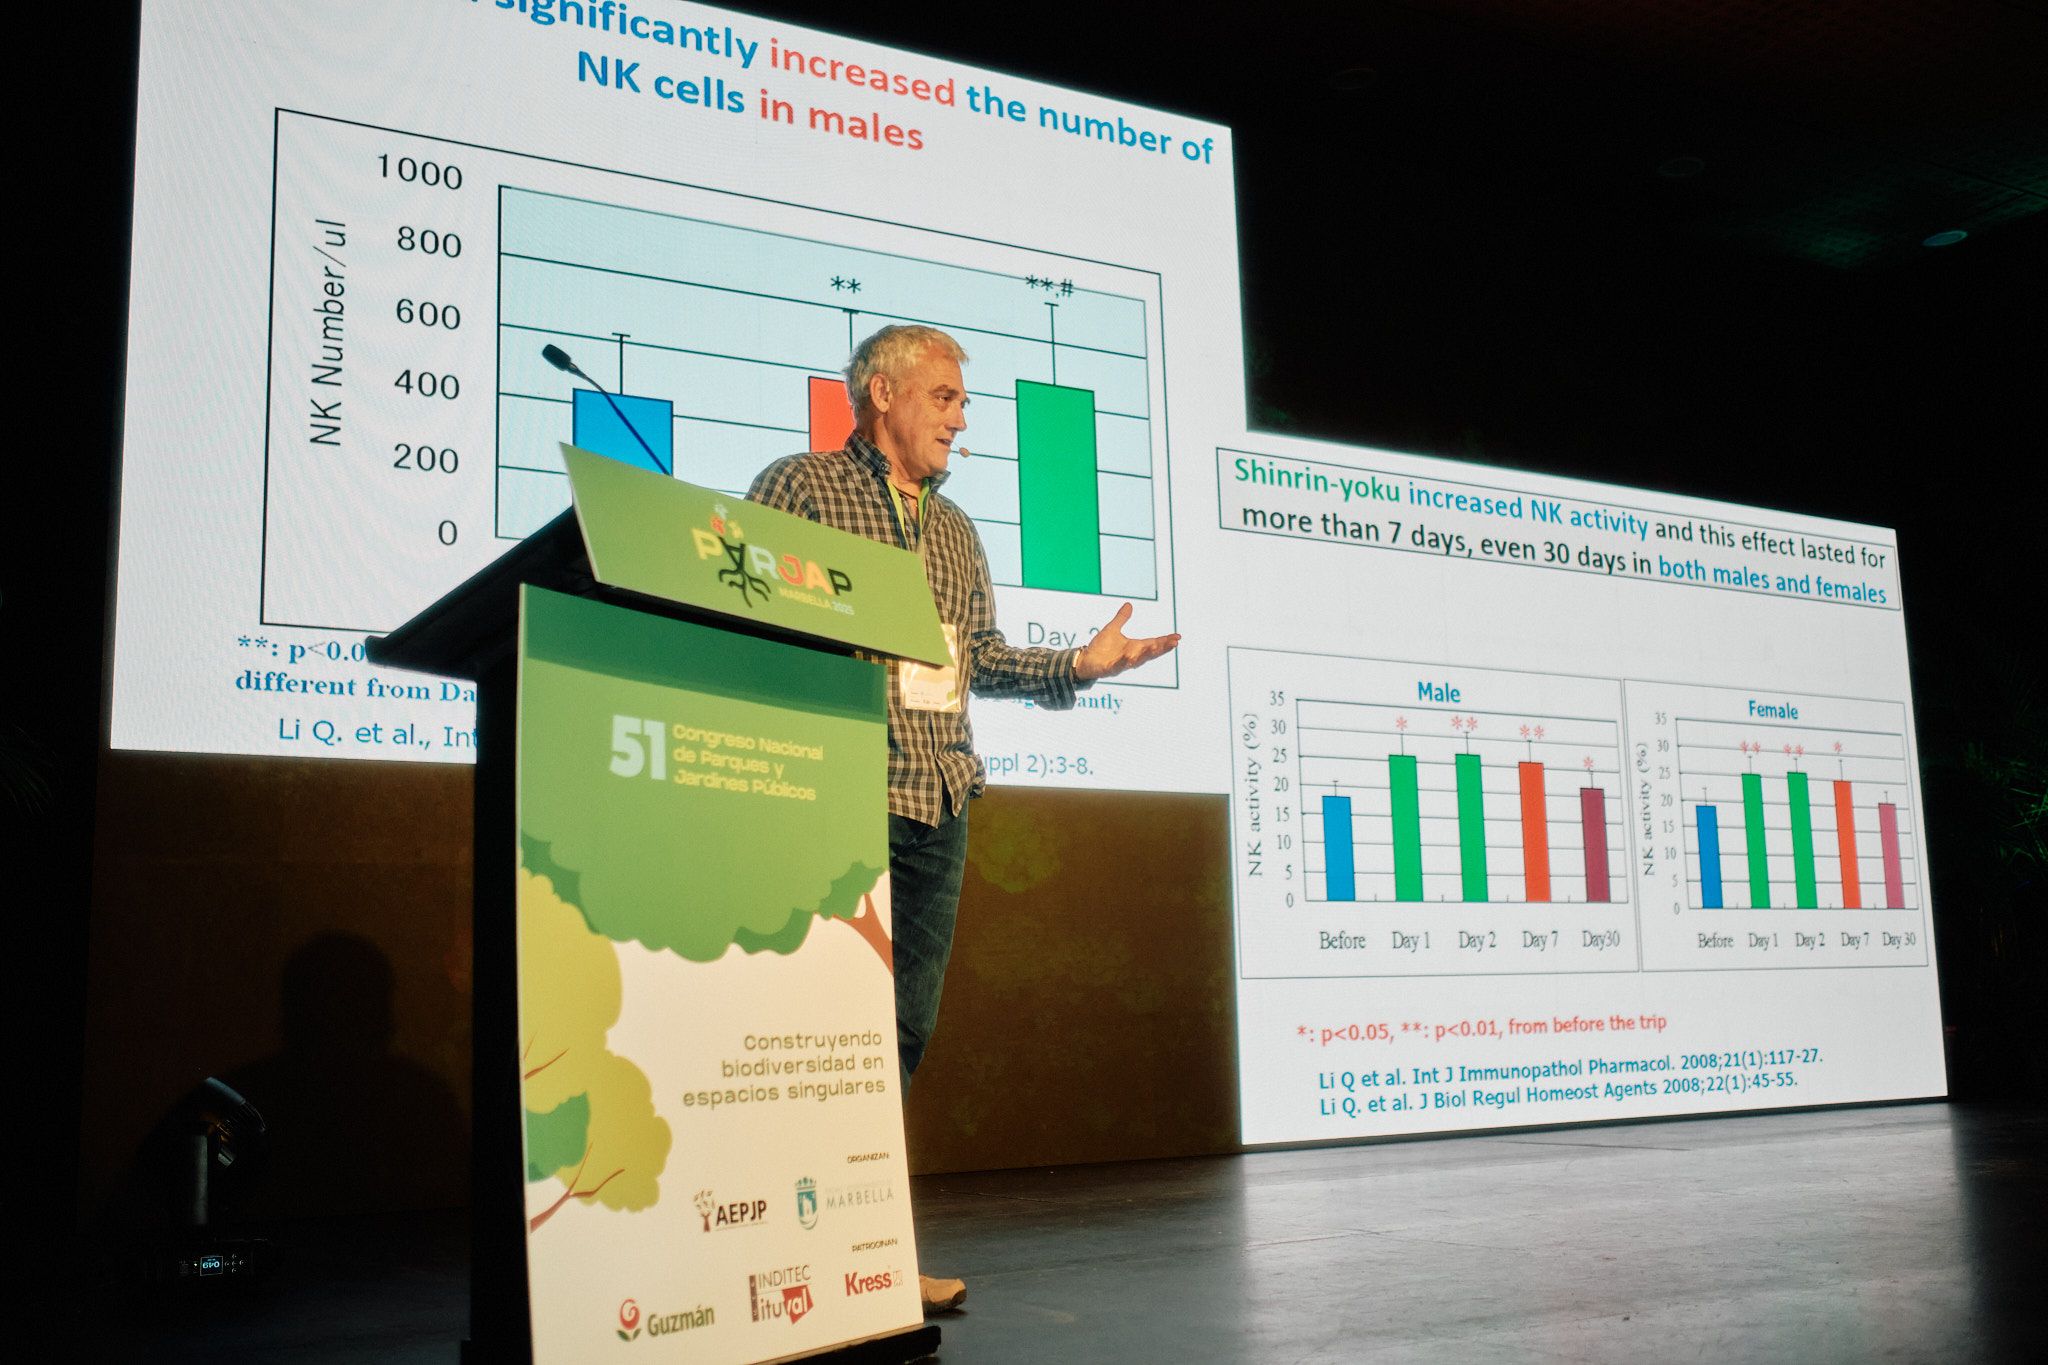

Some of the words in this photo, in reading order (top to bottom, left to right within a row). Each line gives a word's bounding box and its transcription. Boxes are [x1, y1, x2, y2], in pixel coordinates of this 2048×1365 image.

[496, 0, 758, 69] gnificantly
[771, 39, 955, 107] increased
[967, 86, 1026, 122] the
[1040, 107, 1171, 155] number
[1182, 138, 1214, 165] of
[579, 51, 640, 93] NK
[654, 76, 745, 113] cells
[760, 89, 794, 125] in
[809, 108, 924, 152] males
[377, 153, 463, 190] 1000
[397, 226, 462, 258] 800
[311, 219, 346, 386] Number/ul
[396, 298, 461, 330] 600
[394, 369, 460, 400] 400
[310, 399, 342, 446] NK
[393, 443, 460, 475] 200
[1235, 458, 1400, 503] Shinrin-yoku
[1409, 481, 1523, 518] increased
[1531, 499, 1562, 524] NK
[1570, 507, 1649, 541] activity
[1655, 521, 1693, 542] and
[1700, 525, 1735, 548] this
[1742, 532, 1796, 557] effect
[1801, 538, 1855, 564] lasted
[1861, 548, 1886, 569] for
[437, 520, 459, 547] 0
[1242, 507, 1313, 533] more
[1321, 512, 1379, 542] than
[1388, 521, 1402, 544] 7
[1411, 524, 1474, 558] days,
[1481, 537, 1536, 561] even
[1544, 541, 1569, 564] 30
[1577, 546, 1626, 575] days
[1633, 552, 1651, 574] in
[1659, 555, 1706, 581] both
[1713, 566, 1770, 590] males
[1776, 574, 1810, 594] and
[1816, 577, 1887, 604] females
[1028, 622, 1076, 648] Day
[236, 670, 356, 696] different
[367, 678, 430, 700] from
[439, 681, 476, 702] Da
[1418, 681, 1461, 703] Male
[1270, 691, 1285, 707] 35
[1749, 700, 1799, 719] Female
[1271, 720, 1287, 734] 30
[1655, 712, 1667, 725] 35
[279, 718, 300, 740] Li
[313, 720, 342, 746] Q.
[356, 723, 382, 744] et
[393, 723, 431, 750] al.,
[672, 724, 755, 750] Congreso
[759, 737, 824, 760] Nacional
[1242, 712, 1260, 750] (%)
[609, 714, 667, 780] 51
[1273, 749, 1287, 763] 25
[1657, 740, 1669, 752] 30
[673, 747, 696, 763] de
[701, 750, 769, 774] Parques
[774, 763, 785, 779] y
[1027, 754, 1094, 778] 2):3-8.
[1659, 766, 1671, 779] 25
[674, 769, 749, 793] Jardines
[753, 778, 816, 801] Públicos
[1246, 752, 1262, 834] activity
[1274, 778, 1289, 792] 20
[1641, 774, 1654, 840] activity
[1661, 793, 1673, 807] 20
[1276, 806, 1290, 821] 15
[1663, 820, 1675, 832] 15
[1276, 834, 1291, 849] 10
[1664, 847, 1676, 860] 10
[1247, 842, 1263, 877] NK
[1644, 846, 1655, 876] NK
[1285, 865, 1292, 880] 5
[1286, 893, 1294, 908] 0
[1319, 930, 1366, 949] Before
[1392, 930, 1419, 953] Day
[1424, 931, 1430, 948] 1
[1458, 930, 1485, 952] Day
[1487, 931, 1498, 947] 2
[1522, 930, 1548, 951] Day
[1551, 931, 1558, 946] 7
[1697, 932, 1735, 949] Before
[1749, 932, 1770, 950] Day
[1795, 932, 1817, 949] Day
[1818, 933, 1826, 947] 2
[1841, 932, 1861, 949] Day
[1863, 932, 1870, 946] 7
[1883, 932, 1904, 949] Day
[744, 1030, 882, 1053] Construyendo
[1321, 1022, 1394, 1046] p<0.05,
[1435, 1019, 1503, 1042] p<0.01,
[1509, 1018, 1548, 1035] from
[1553, 1016, 1603, 1034] before
[1609, 1015, 1635, 1032] the
[1639, 1014, 1667, 1034] trip
[722, 1055, 855, 1078] biodiversidad
[862, 1057, 884, 1071] en
[1319, 1071, 1336, 1090] Li
[1340, 1071, 1356, 1092] Q
[1361, 1070, 1380, 1087] et
[1384, 1069, 1406, 1086] al.
[1412, 1067, 1440, 1084] Int
[1444, 1066, 1454, 1083] J
[1460, 1057, 1583, 1084] Immunopathol
[1589, 1055, 1676, 1075] Pharmacol.
[1680, 1048, 1823, 1073] 2008;21(1):117-27.
[683, 1085, 780, 1110] espacios
[788, 1078, 886, 1102] singulares
[1321, 1098, 1337, 1116] Li
[1342, 1095, 1361, 1117] Q.
[1368, 1096, 1386, 1112] et
[1390, 1094, 1413, 1111] al.
[1419, 1093, 1429, 1109] J
[1435, 1090, 1468, 1108] Biol
[1473, 1087, 1521, 1109] Regul
[1527, 1081, 1599, 1102] Homeost
[1604, 1079, 1658, 1098] Agents
[1663, 1072, 1798, 1095] 2008;22(1):45-55.
[826, 1187, 894, 1209] MARBELLA
[716, 1200, 767, 1226] AEPJP
[758, 1265, 811, 1289] INDITEC
[845, 1272, 892, 1296] Kress
[647, 1305, 715, 1337] Guzmán
